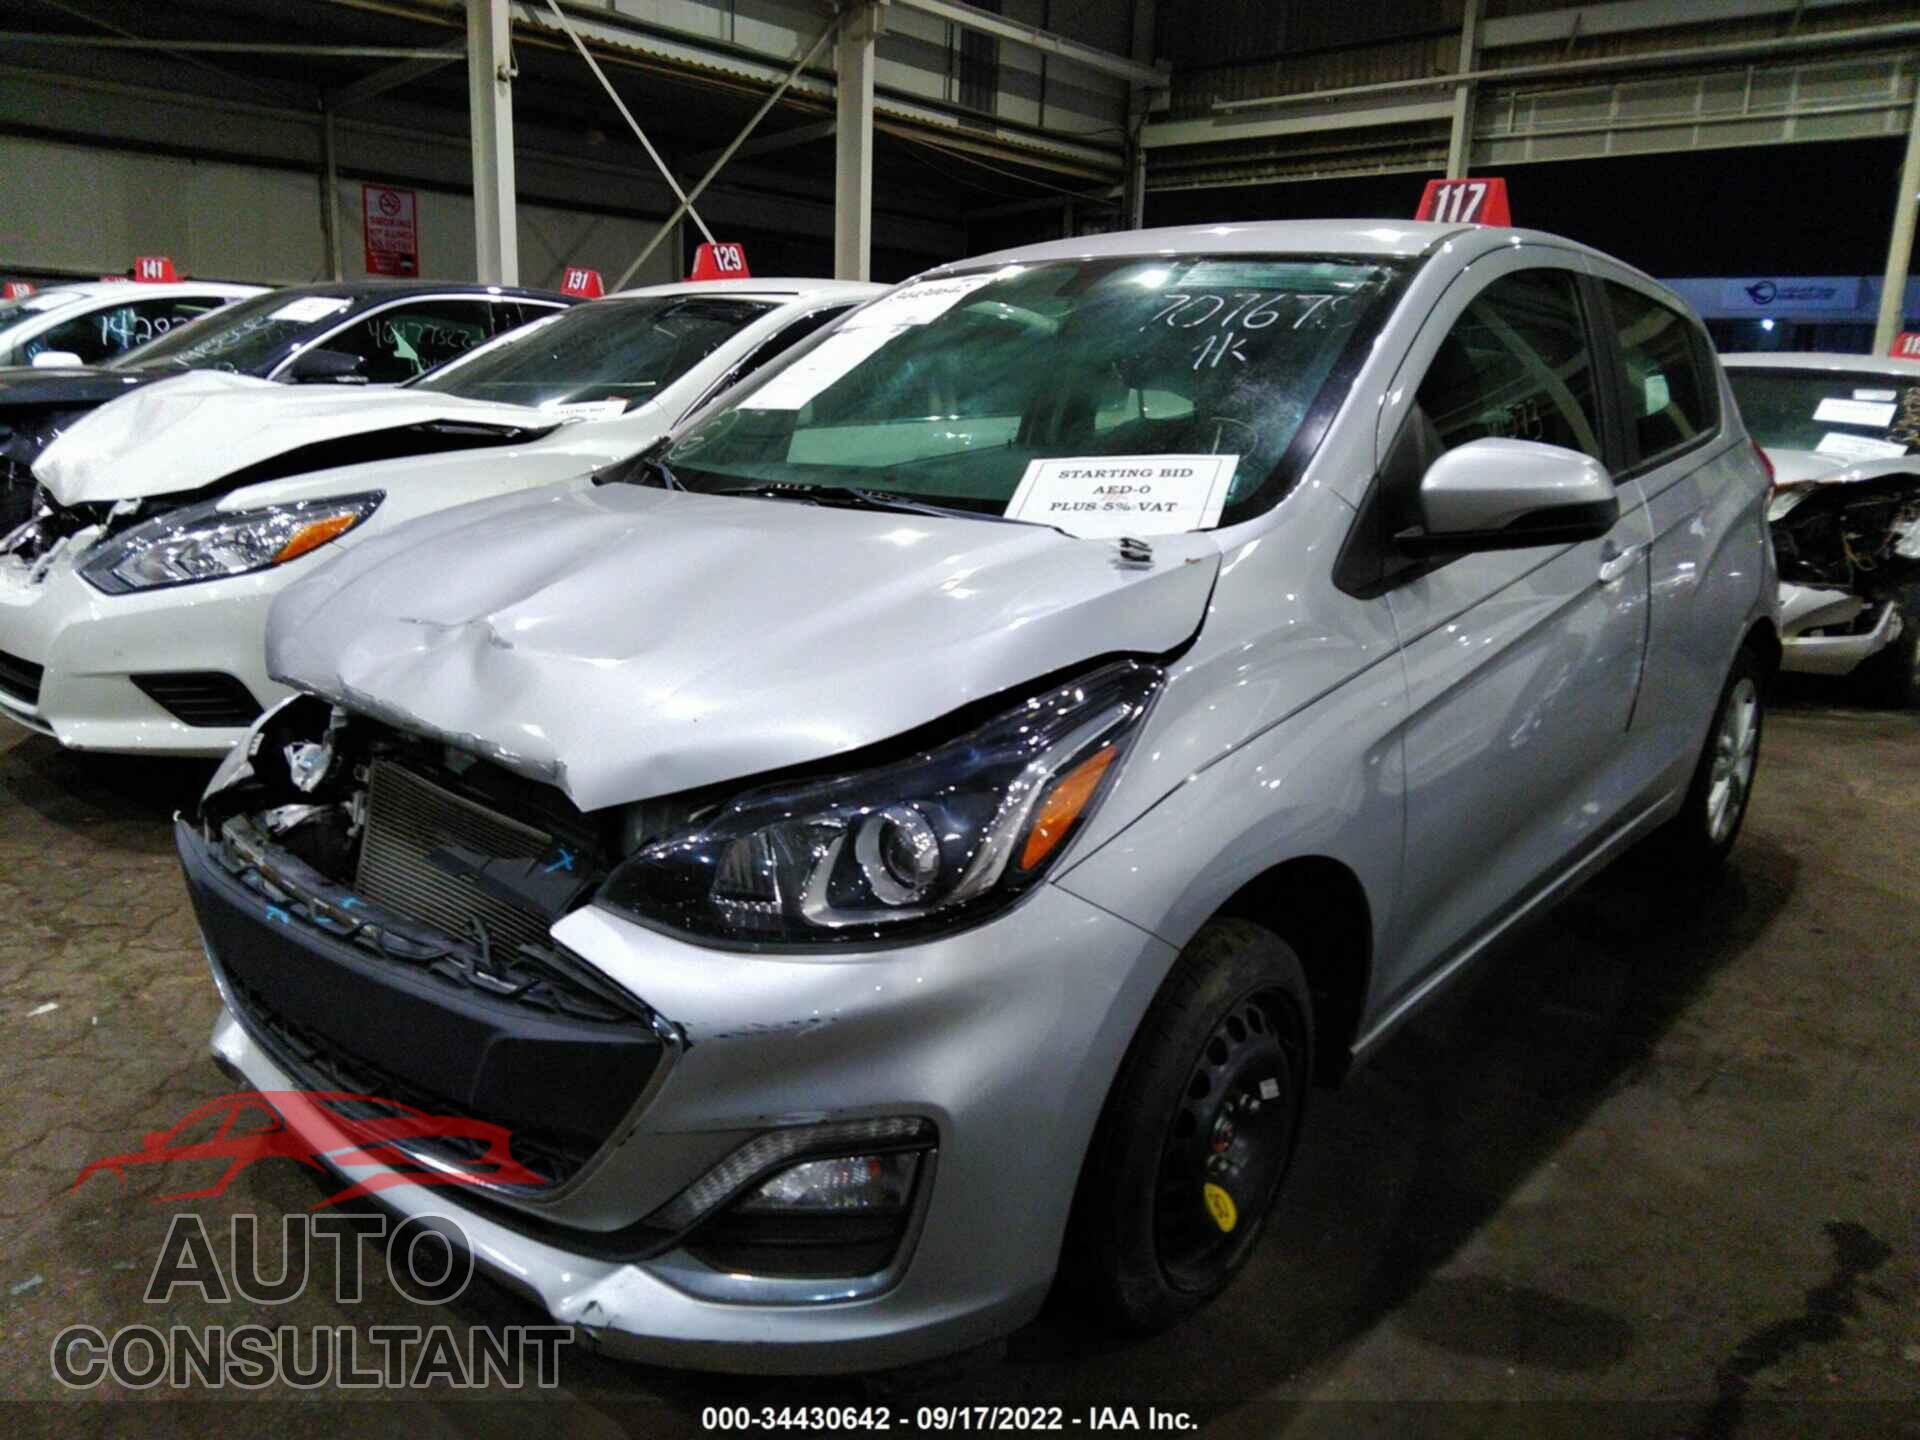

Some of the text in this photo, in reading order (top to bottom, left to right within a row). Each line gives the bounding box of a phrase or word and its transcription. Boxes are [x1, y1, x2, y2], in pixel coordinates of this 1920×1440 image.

[1434, 183, 1487, 224] 117
[713, 246, 742, 272] 129
[142, 260, 163, 279] 141
[567, 271, 589, 290] 131
[1058, 468, 1194, 480] STARTING BID
[1050, 502, 1097, 512] PLUS
[1140, 502, 1177, 512] VAT
